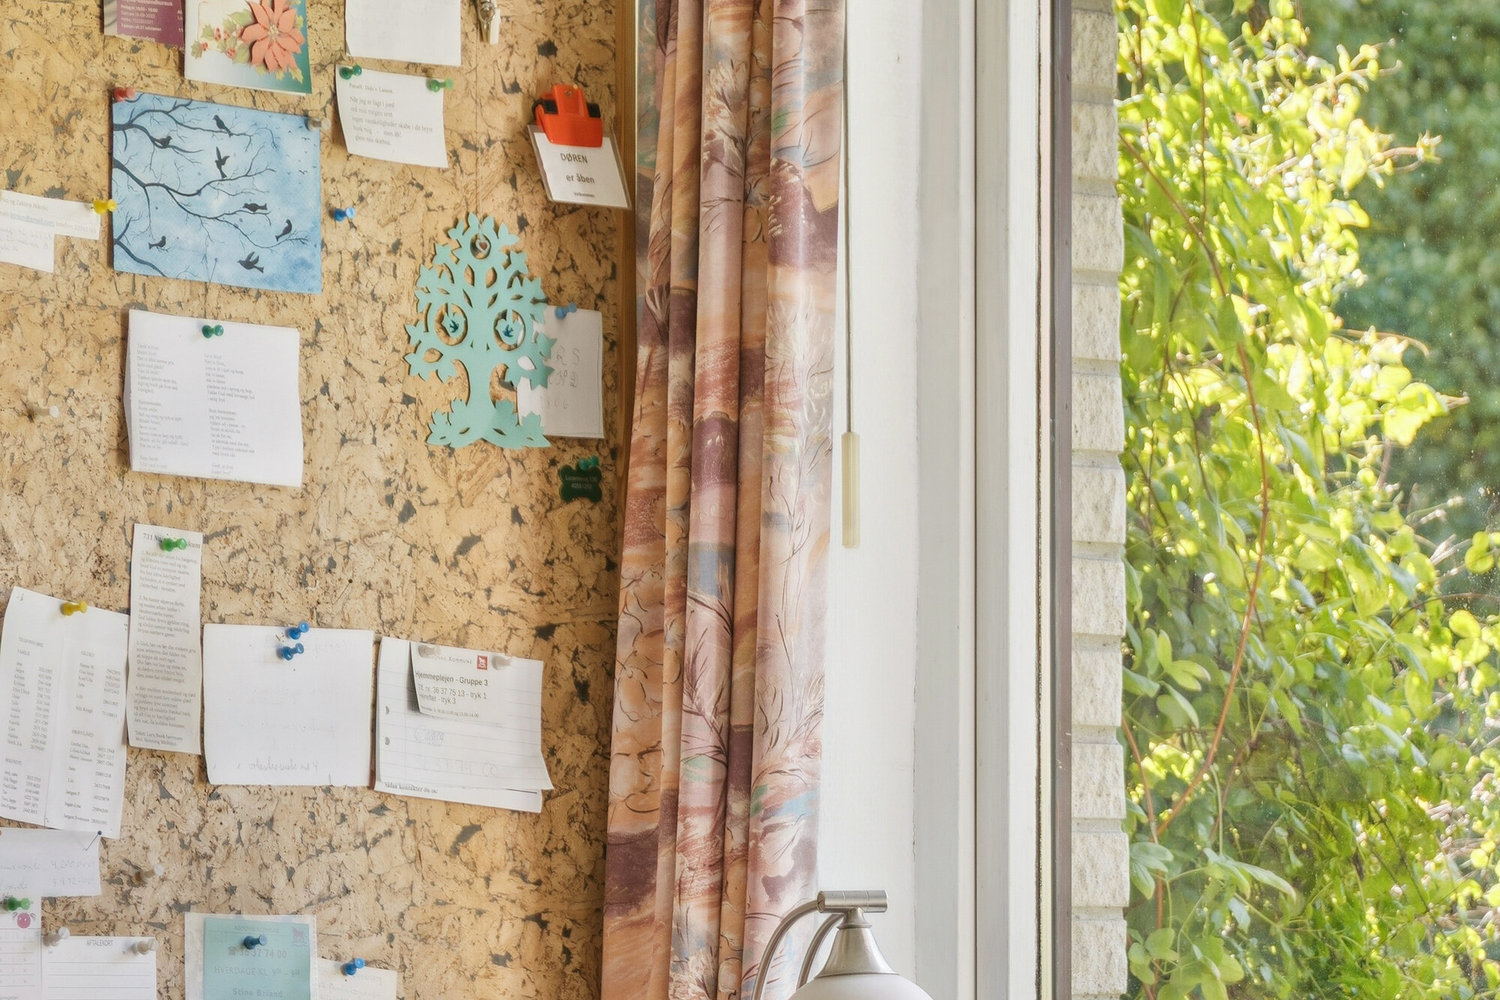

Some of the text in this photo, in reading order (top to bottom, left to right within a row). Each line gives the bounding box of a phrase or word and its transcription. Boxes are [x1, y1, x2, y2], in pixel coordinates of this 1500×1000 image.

[560, 152, 588, 164] DØREN
[566, 172, 595, 184] er åben
[459, 676, 482, 687] Gruppe
[484, 679, 489, 687] 3
[441, 687, 448, 696] 37
[458, 689, 466, 697] 13
[214, 966, 256, 976] HVERDAGE
